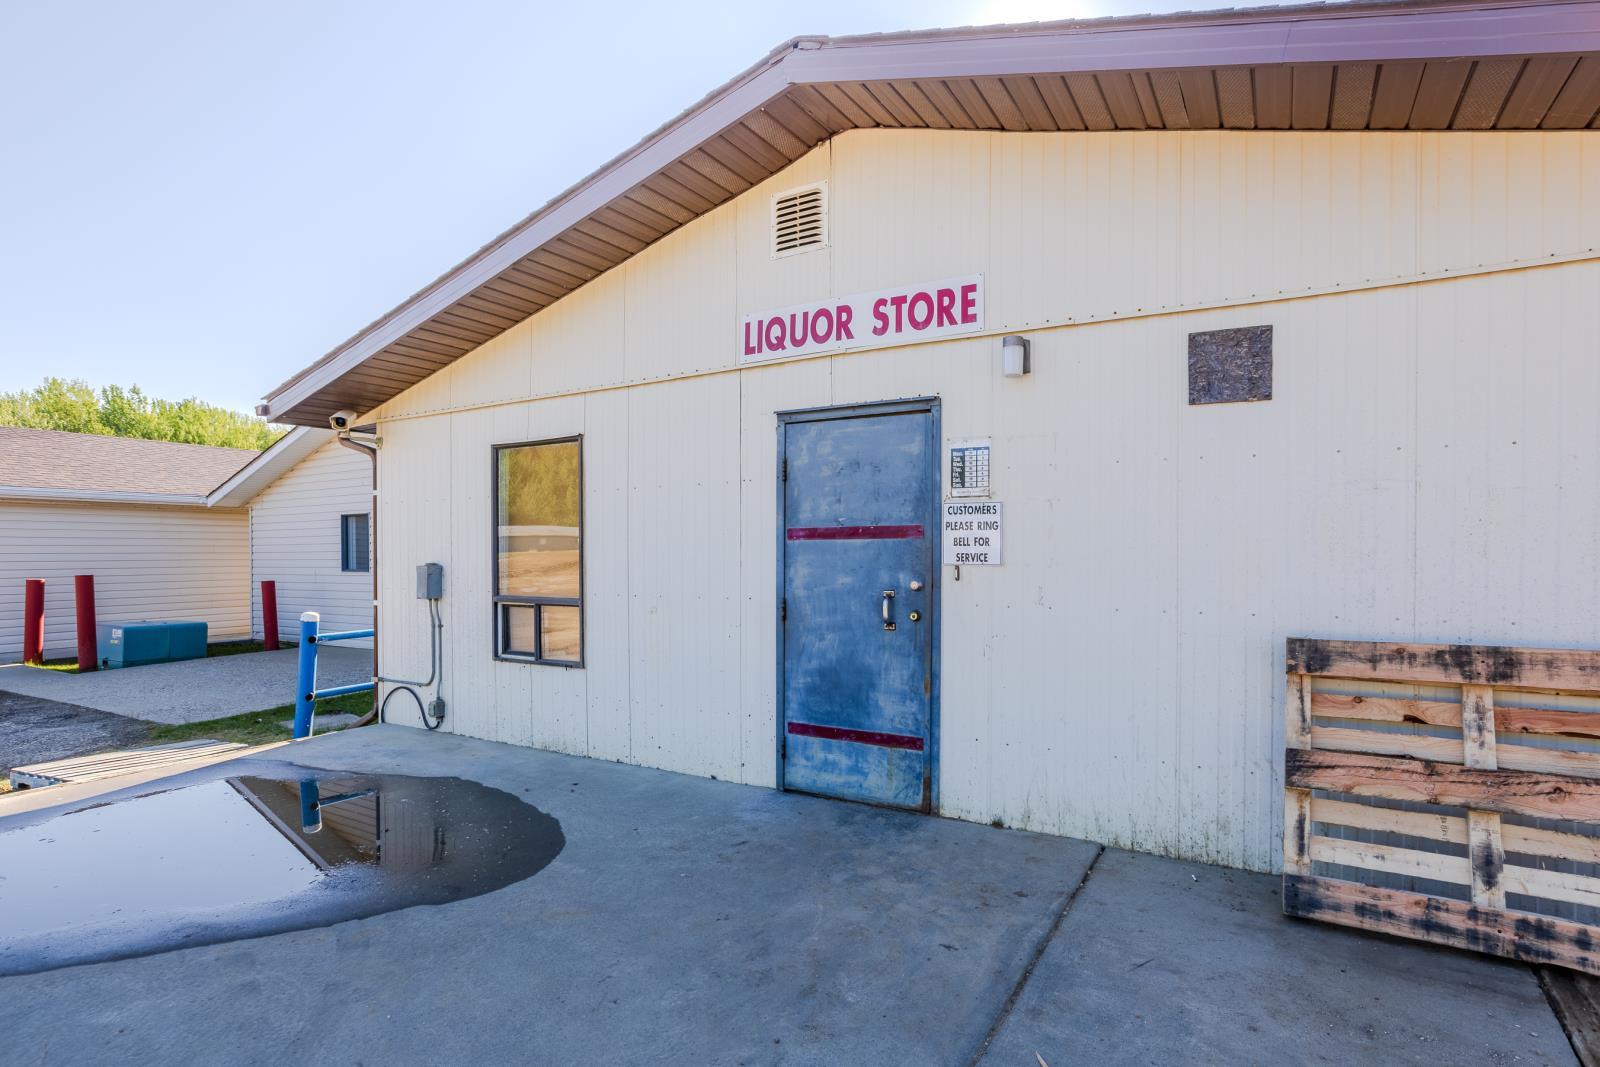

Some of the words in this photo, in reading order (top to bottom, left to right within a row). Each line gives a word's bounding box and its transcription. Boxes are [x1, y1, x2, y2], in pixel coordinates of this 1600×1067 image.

[744, 304, 854, 356] LIQUOR
[872, 283, 977, 336] STORE
[947, 504, 997, 515] CUSTOMERS
[945, 521, 974, 531] PLEASE
[977, 521, 999, 531] RING
[953, 537, 971, 547] BELL
[974, 537, 990, 547] FOR
[956, 552, 989, 563] SERVICE
